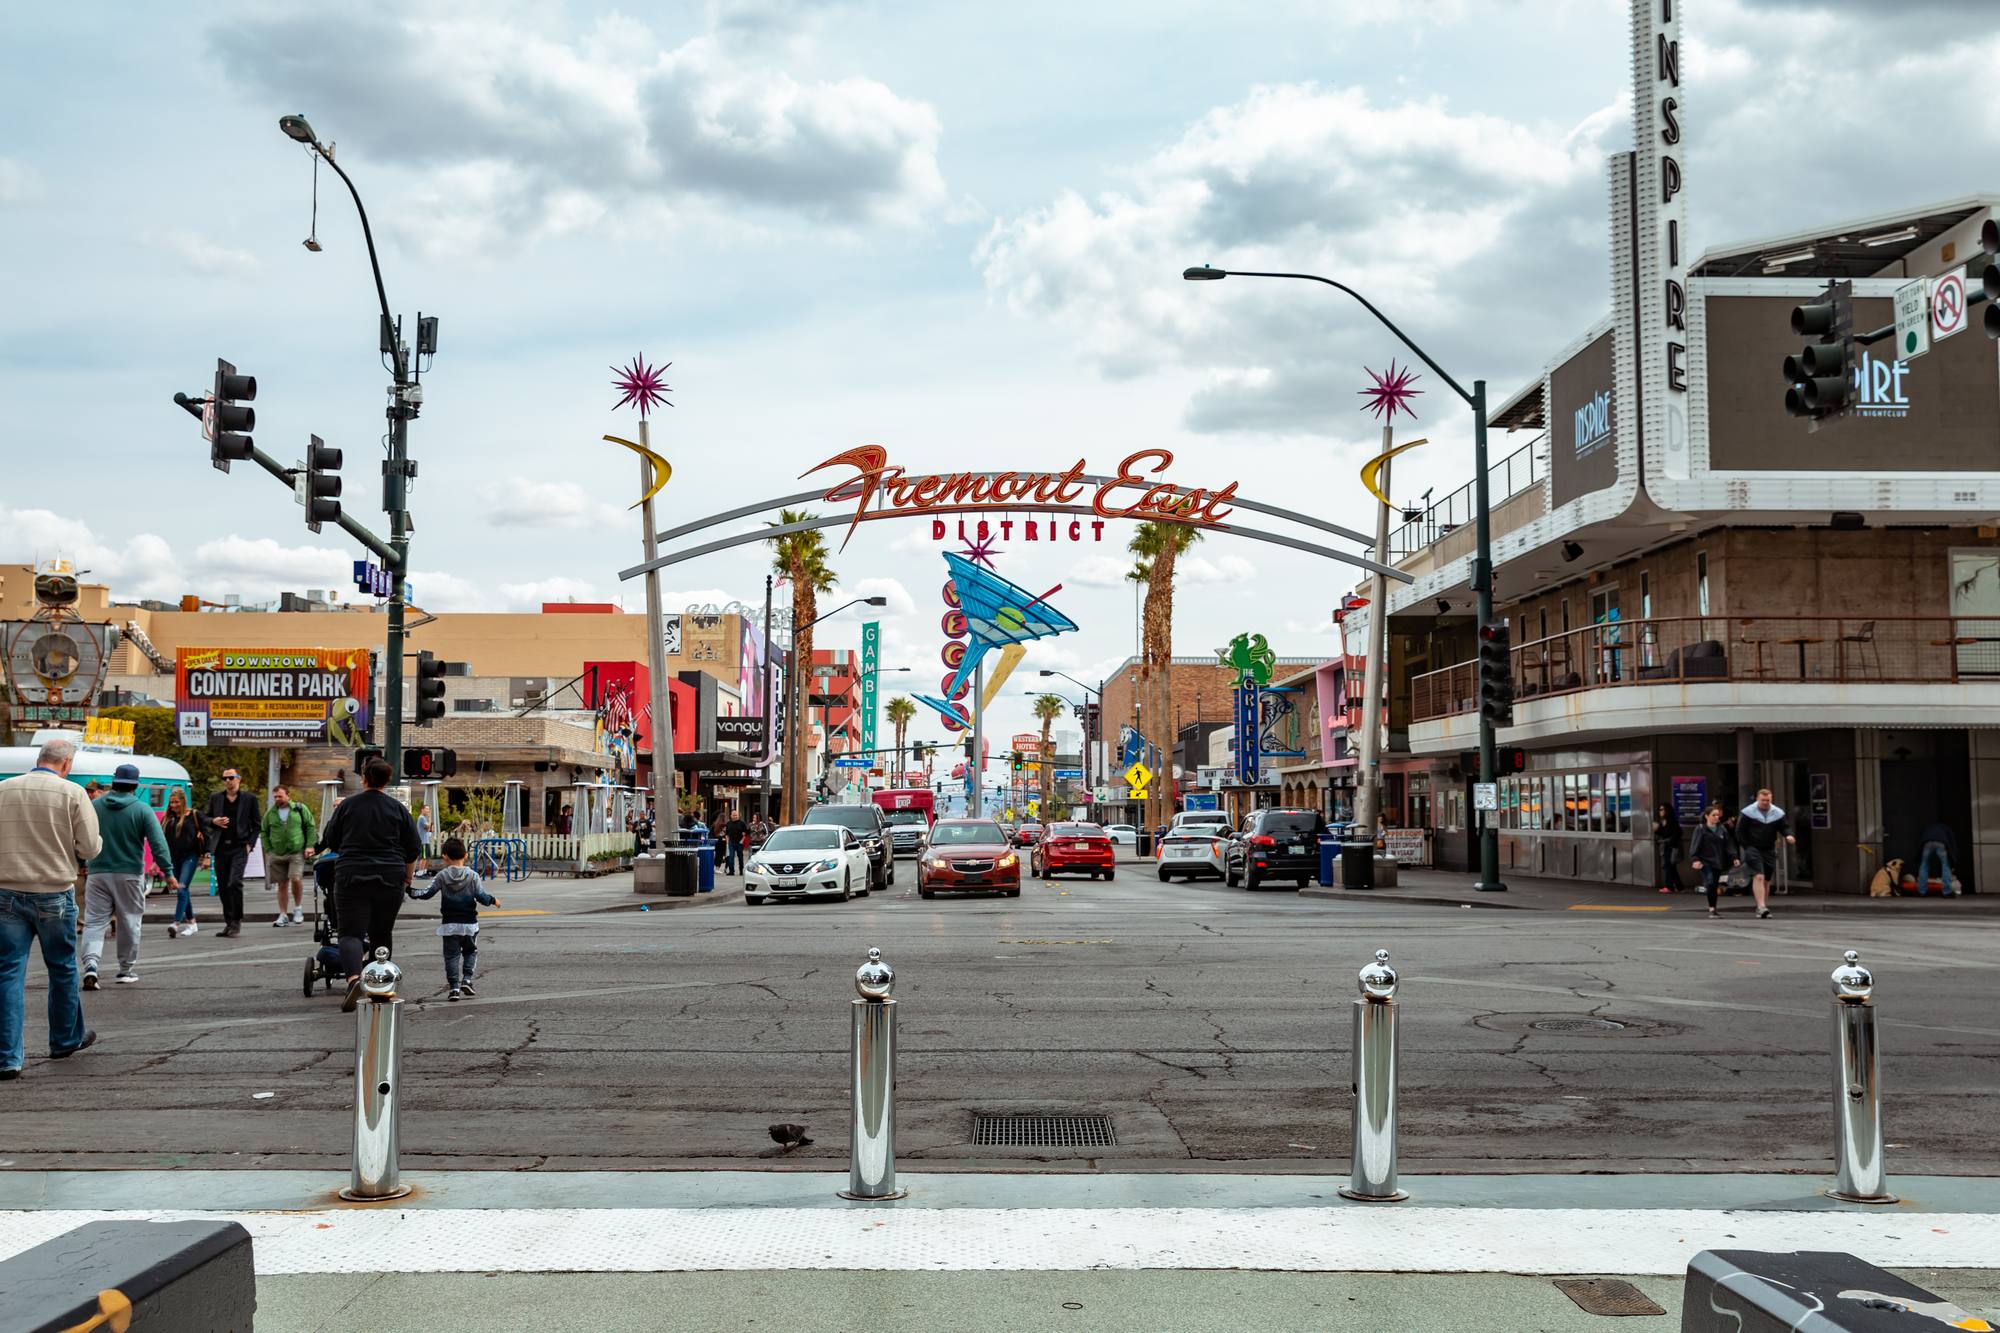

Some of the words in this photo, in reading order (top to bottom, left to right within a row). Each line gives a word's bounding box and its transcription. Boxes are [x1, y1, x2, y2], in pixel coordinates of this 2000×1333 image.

[1901, 299, 1919, 316] YIELD
[1906, 312, 1924, 328] GREEN
[1575, 390, 1611, 449] INSPIRE
[1862, 410, 1907, 418] NIGHTCLUB
[798, 444, 1086, 553] Fremont
[1092, 448, 1240, 523] East
[933, 520, 1105, 541] DISTRICT
[225, 656, 316, 666] DOWNTOWN
[1243, 668, 1254, 677] THE
[190, 671, 293, 697] CONTAINER
[298, 673, 347, 697] PARK
[864, 628, 876, 761] GAMBLING
[717, 722, 784, 735] vangud
[1243, 678, 1254, 783] GRIFFIN
